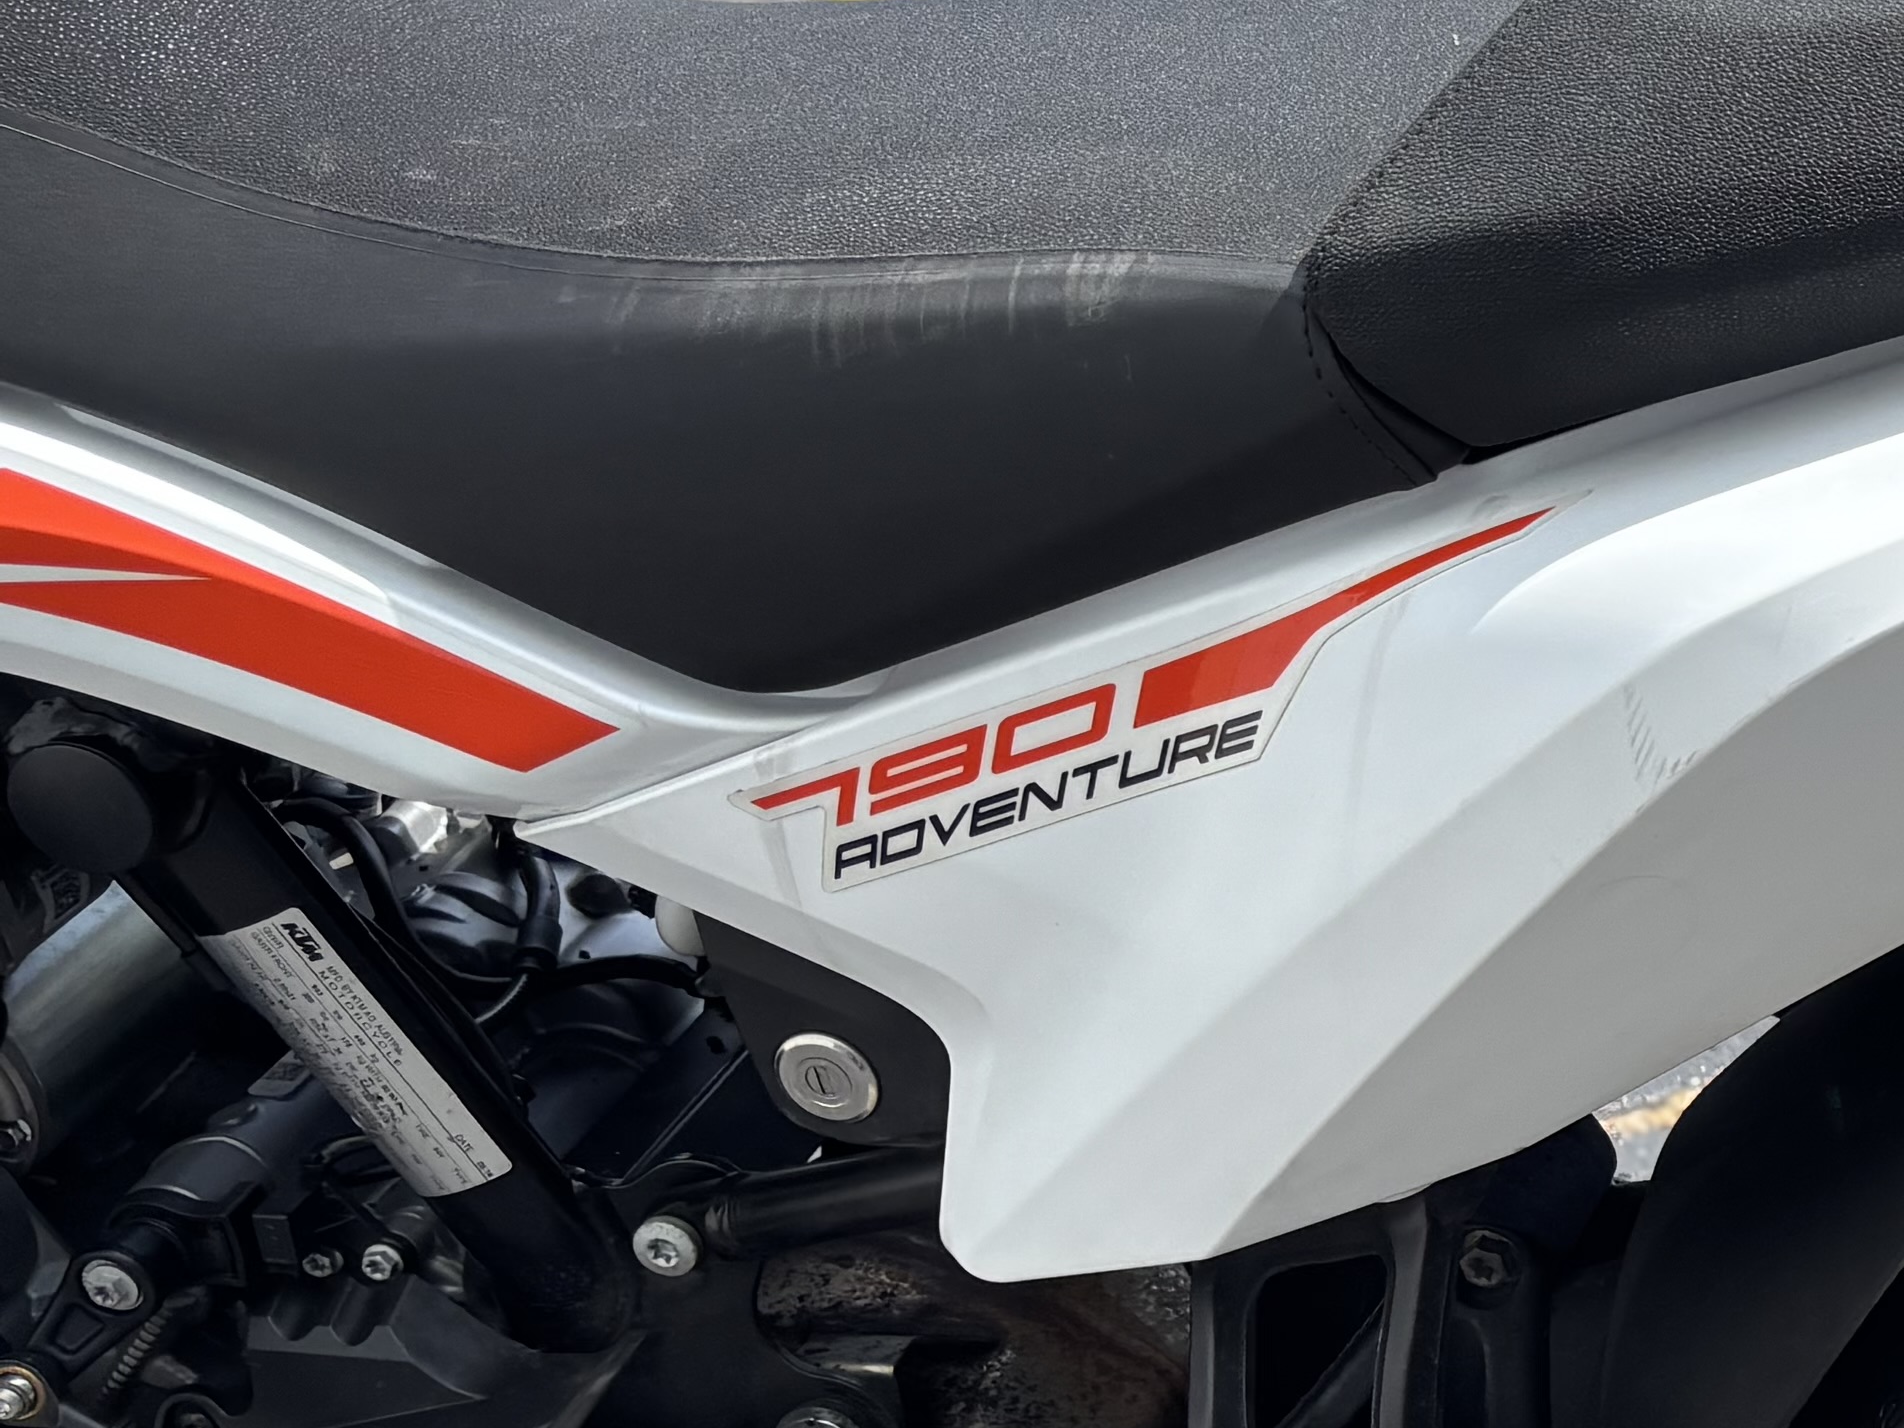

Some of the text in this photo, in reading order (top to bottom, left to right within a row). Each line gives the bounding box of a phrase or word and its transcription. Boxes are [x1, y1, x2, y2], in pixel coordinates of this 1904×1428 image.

[751, 683, 1115, 826] 790
[835, 710, 1263, 879] ADVENTURE
[281, 922, 325, 964] KTM
